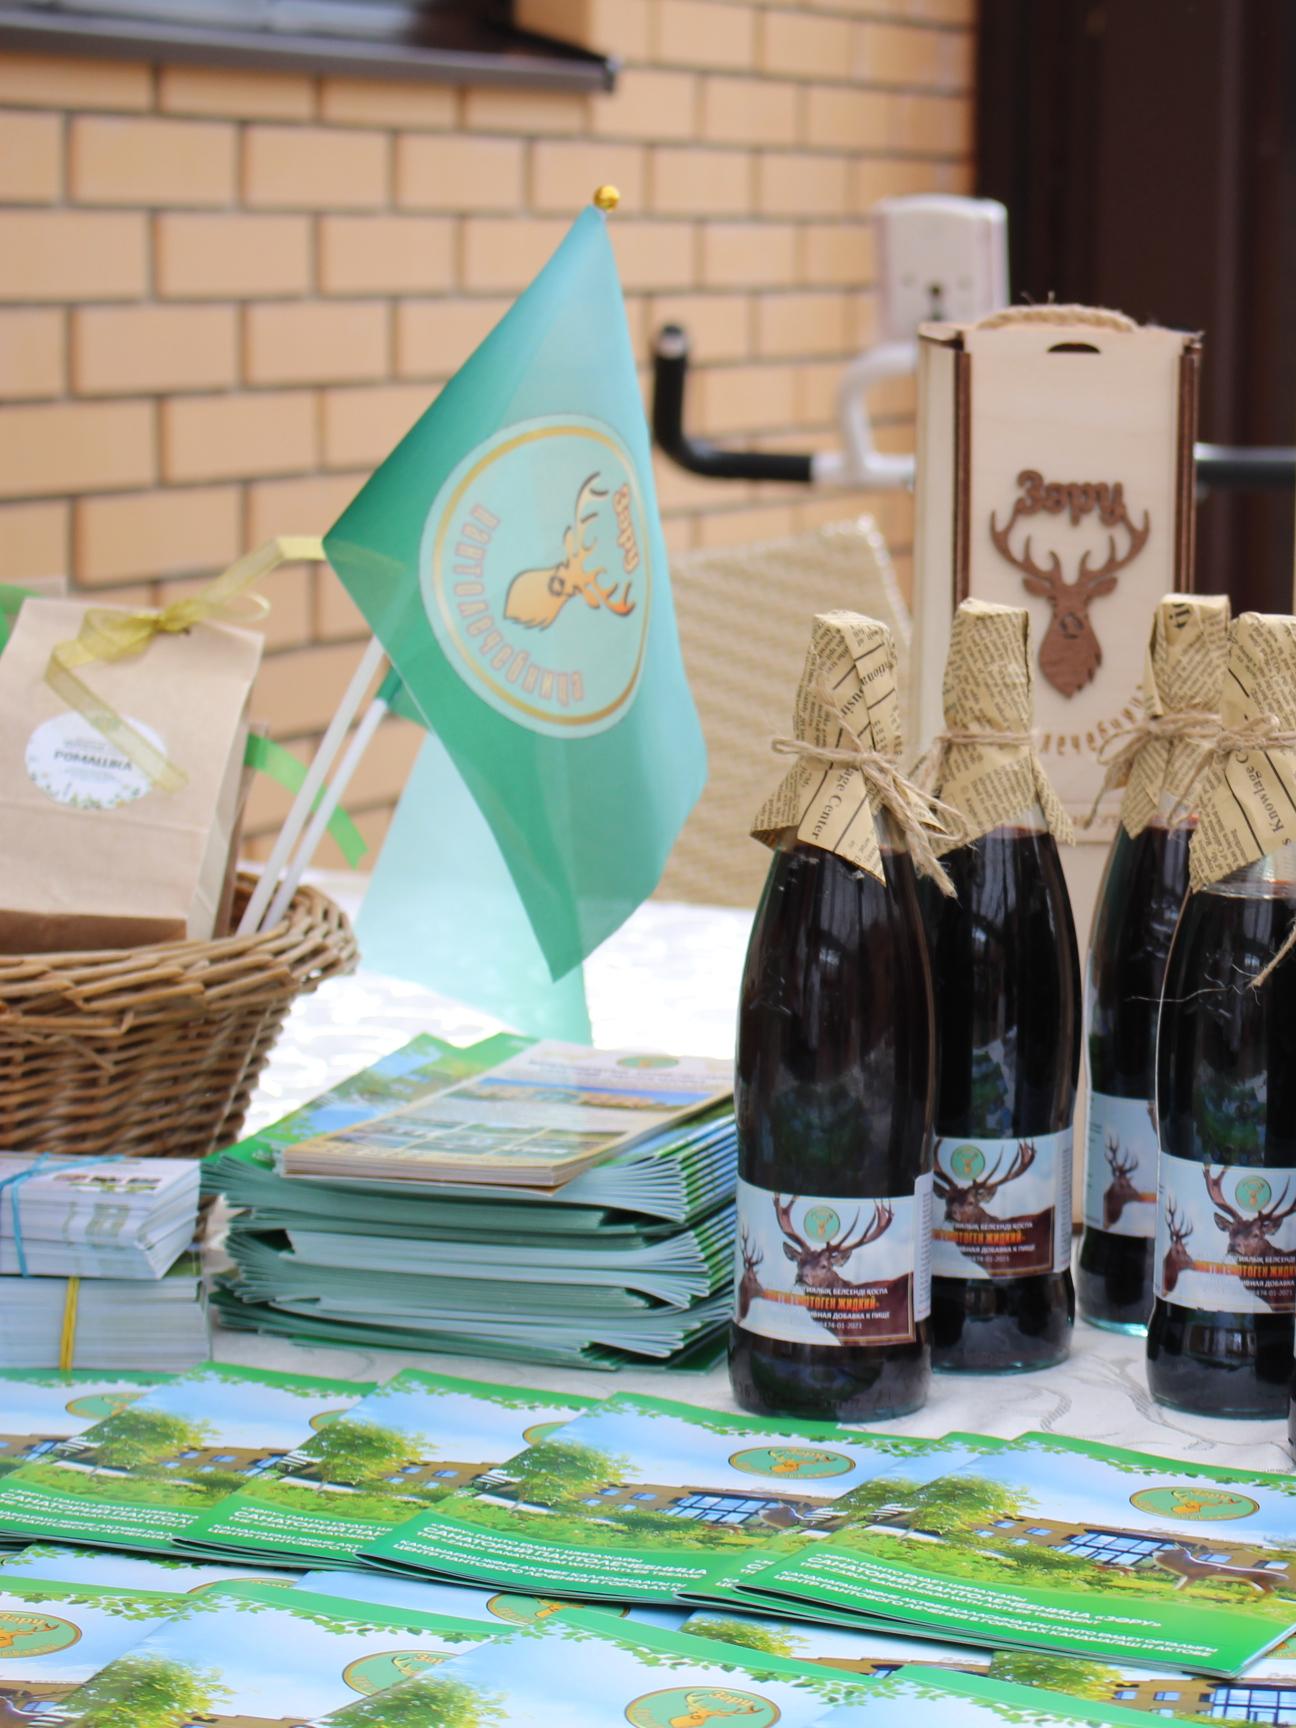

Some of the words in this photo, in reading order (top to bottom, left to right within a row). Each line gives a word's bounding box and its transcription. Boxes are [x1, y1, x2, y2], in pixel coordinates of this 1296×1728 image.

[1244, 763, 1284, 834] Knowlage
[812, 795, 843, 840] Center
[234, 1511, 347, 1532] САНАТОРИЙ
[423, 1527, 534, 1554] САНАТОРИЙ
[774, 1575, 819, 1586] ЦЕНТР
[820, 1584, 904, 1605] ПАНТОВОГО
[807, 1557, 917, 1585] САНАТОРИЙ
[918, 1583, 1091, 1619] ПАНТОЛЕЧЕБНИЦА
